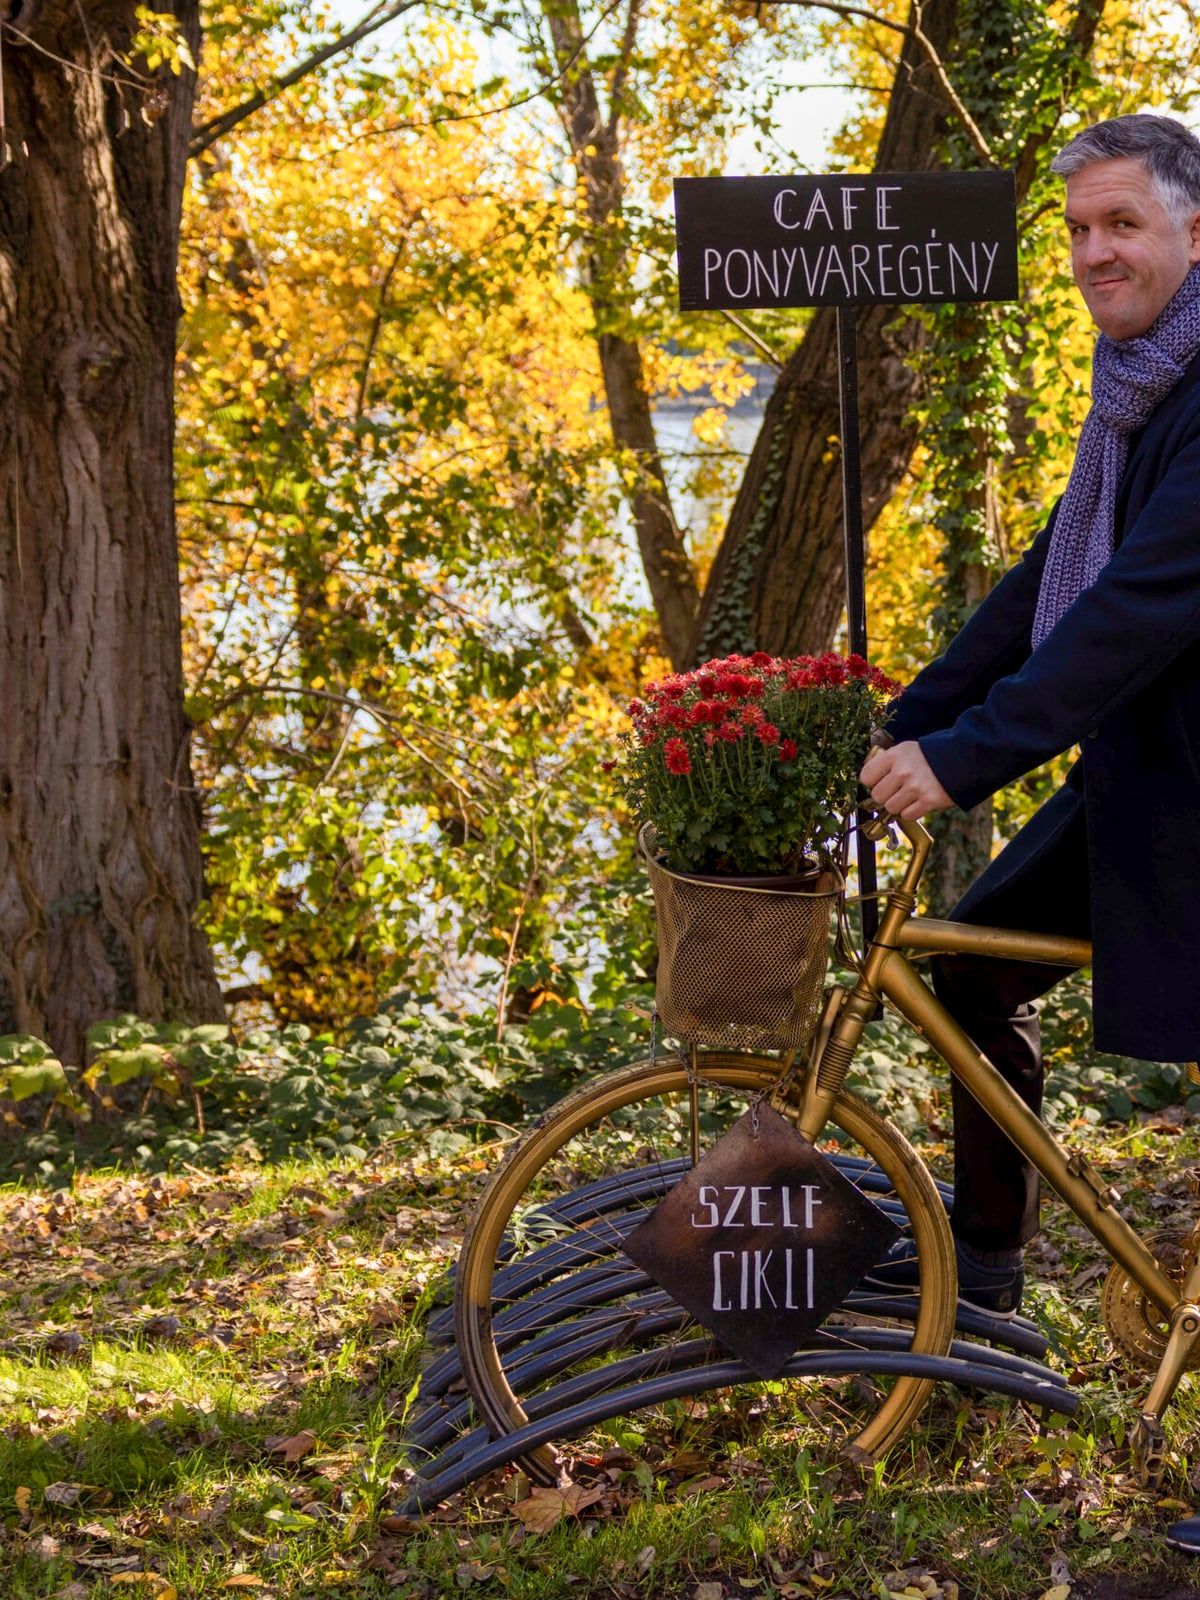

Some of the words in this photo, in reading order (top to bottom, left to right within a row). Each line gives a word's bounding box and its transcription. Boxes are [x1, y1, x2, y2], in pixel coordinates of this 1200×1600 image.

[774, 186, 902, 231] CAFE
[704, 228, 999, 300] PONYVAREGÉNY
[691, 1184, 822, 1229] SZELF
[712, 1248, 814, 1311] CIKLI
